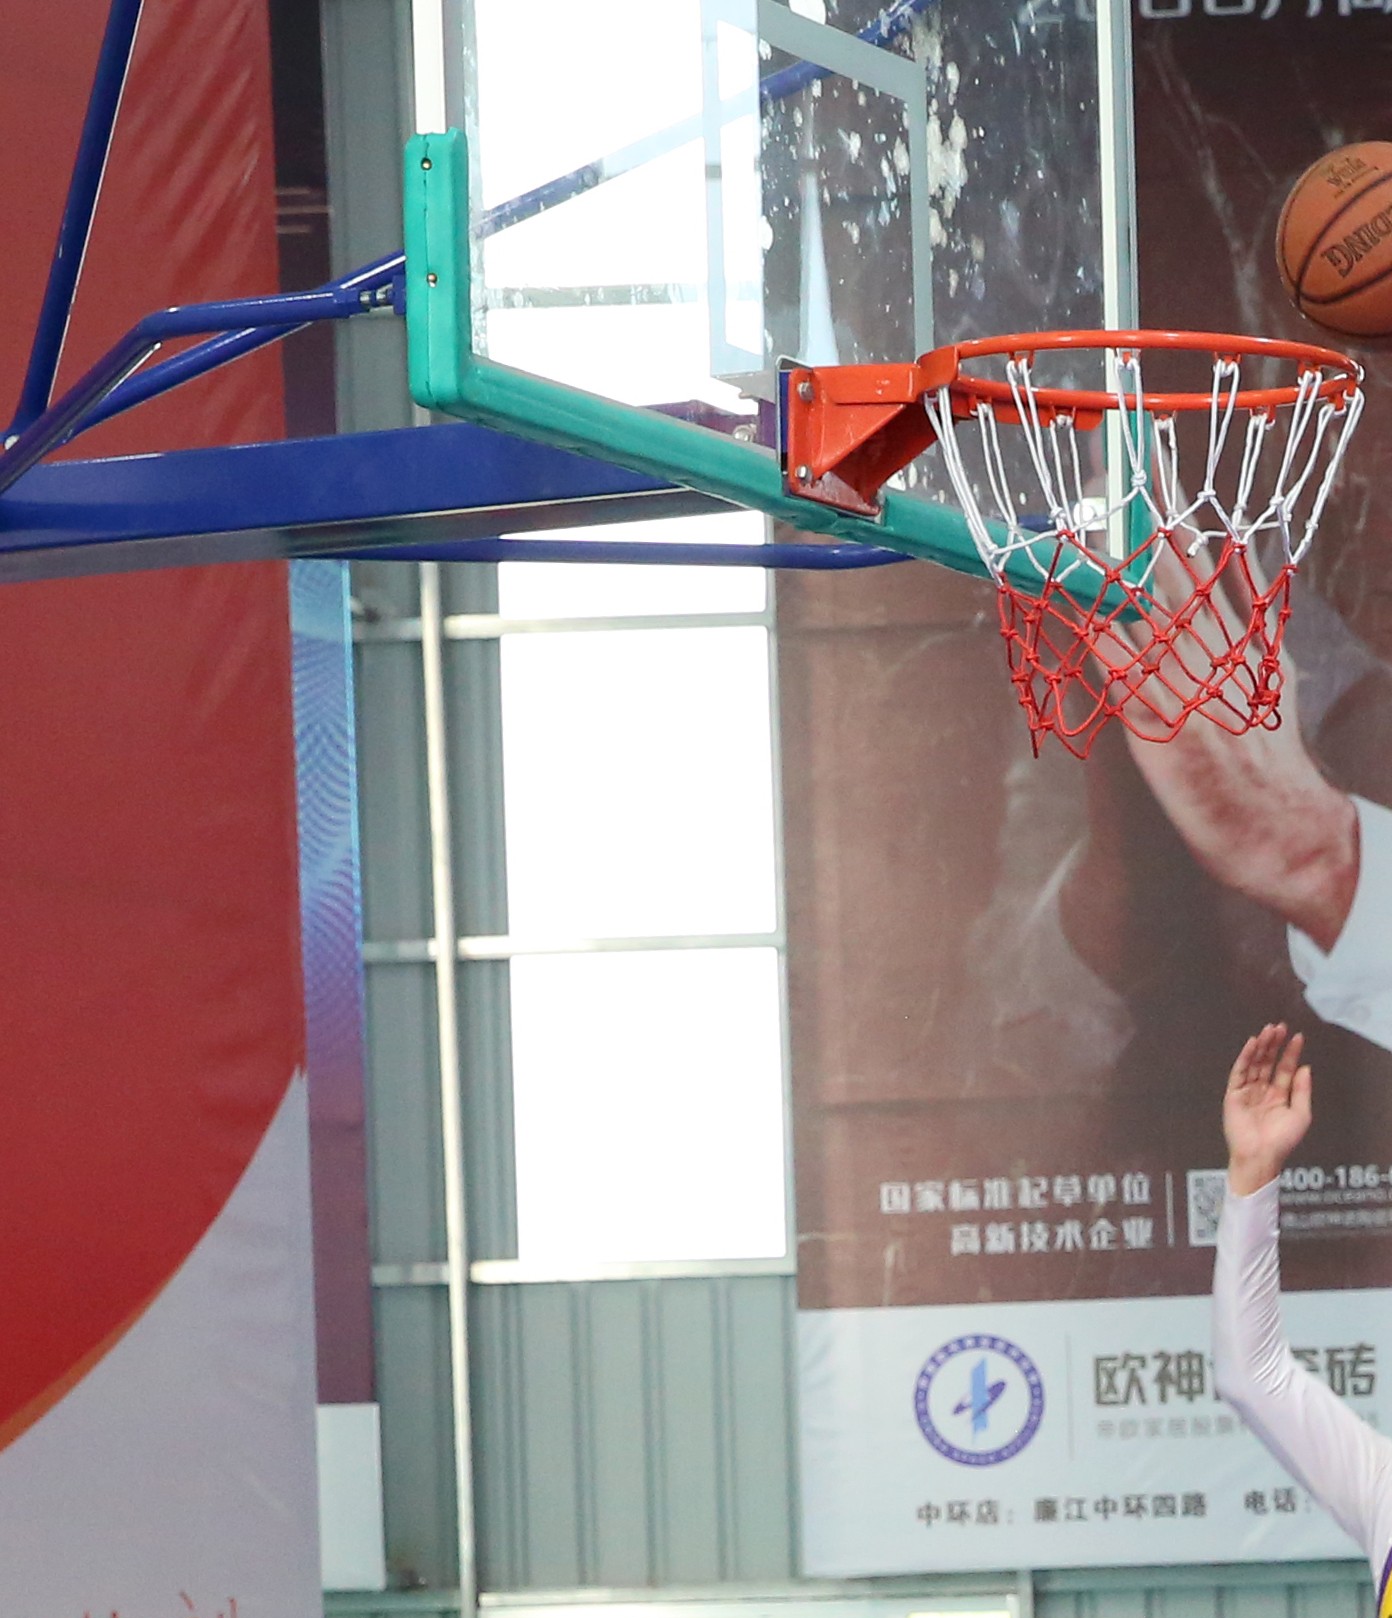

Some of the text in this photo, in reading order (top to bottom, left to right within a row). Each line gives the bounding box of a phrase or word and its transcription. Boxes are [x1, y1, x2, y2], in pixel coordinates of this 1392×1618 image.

[880, 1171, 1153, 1215] 国家标准起草单位
[949, 1217, 1155, 1257] 高新技术企业
[1095, 1343, 1376, 1405] 欧神砖
[1034, 1490, 1208, 1523] 廉江中环四路
